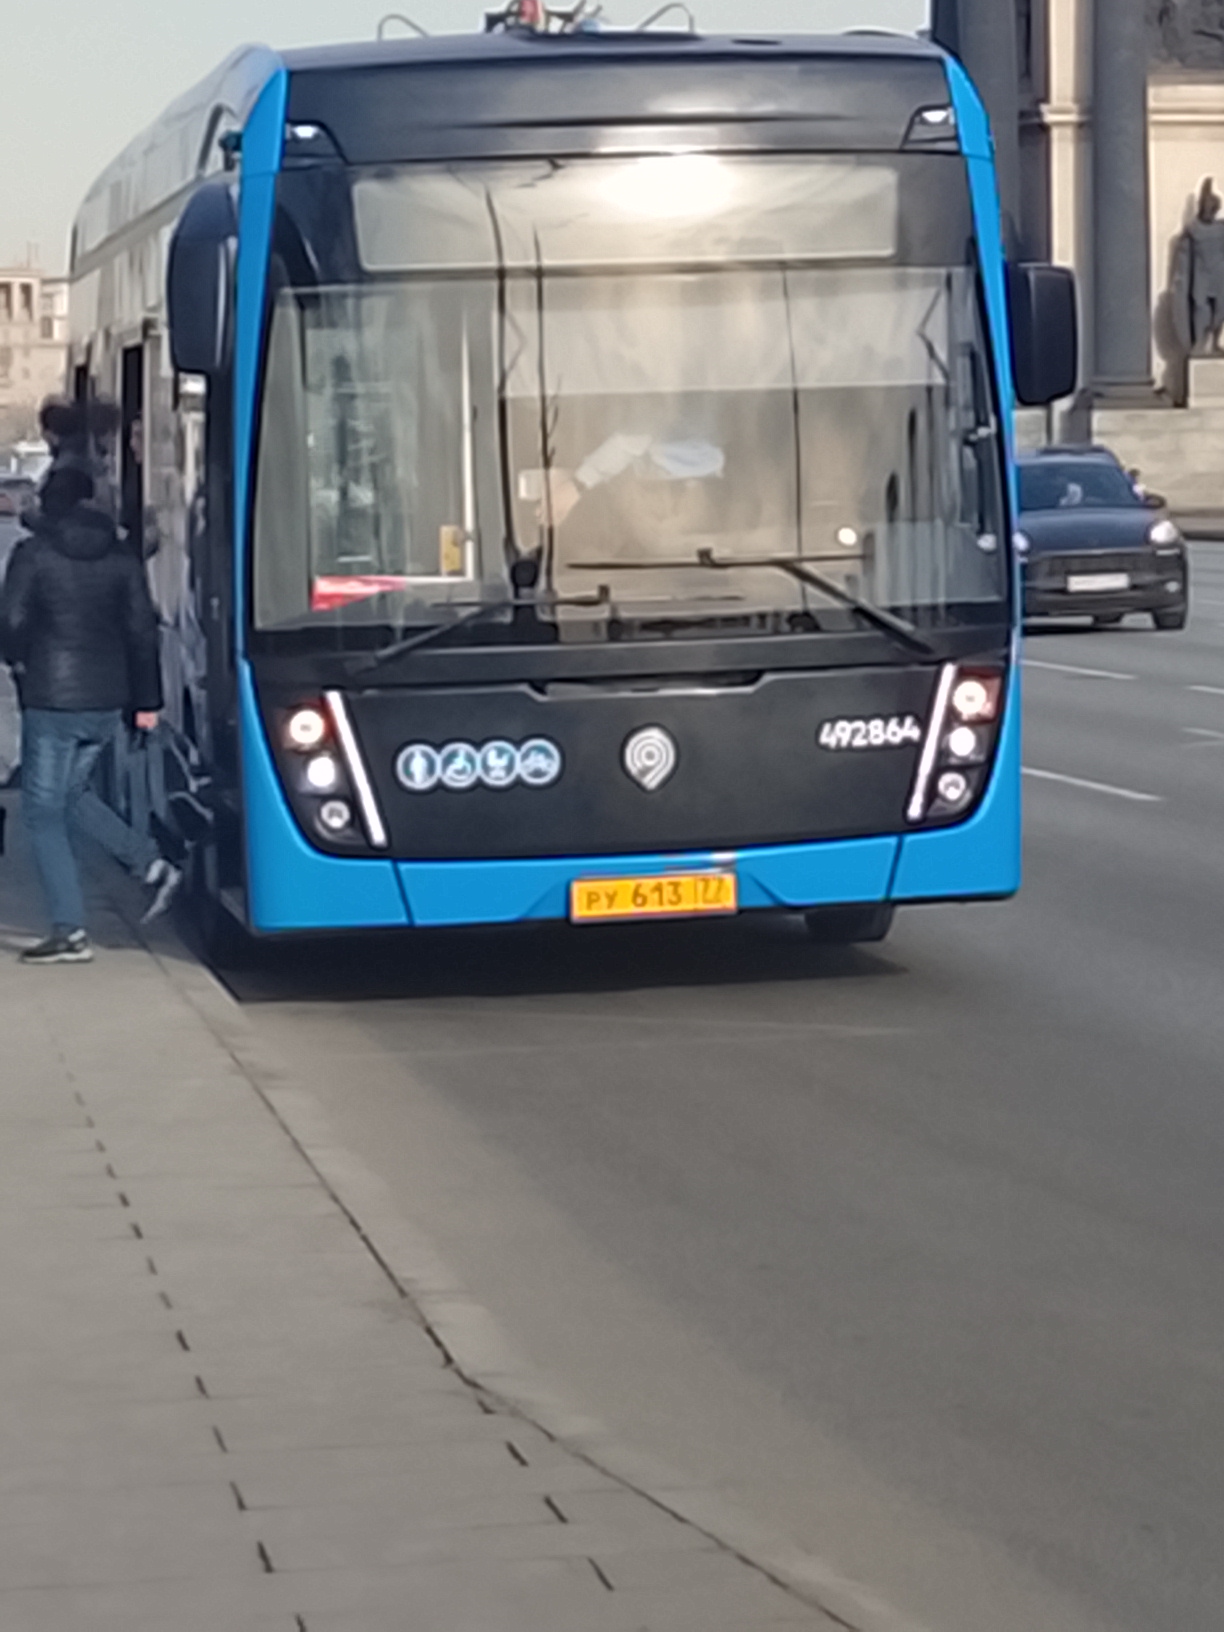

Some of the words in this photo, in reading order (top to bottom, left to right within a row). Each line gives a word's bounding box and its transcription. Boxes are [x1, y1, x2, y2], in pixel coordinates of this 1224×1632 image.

[819, 716, 921, 749] 492864
[586, 890, 618, 911] РУ
[632, 881, 683, 908] 613
